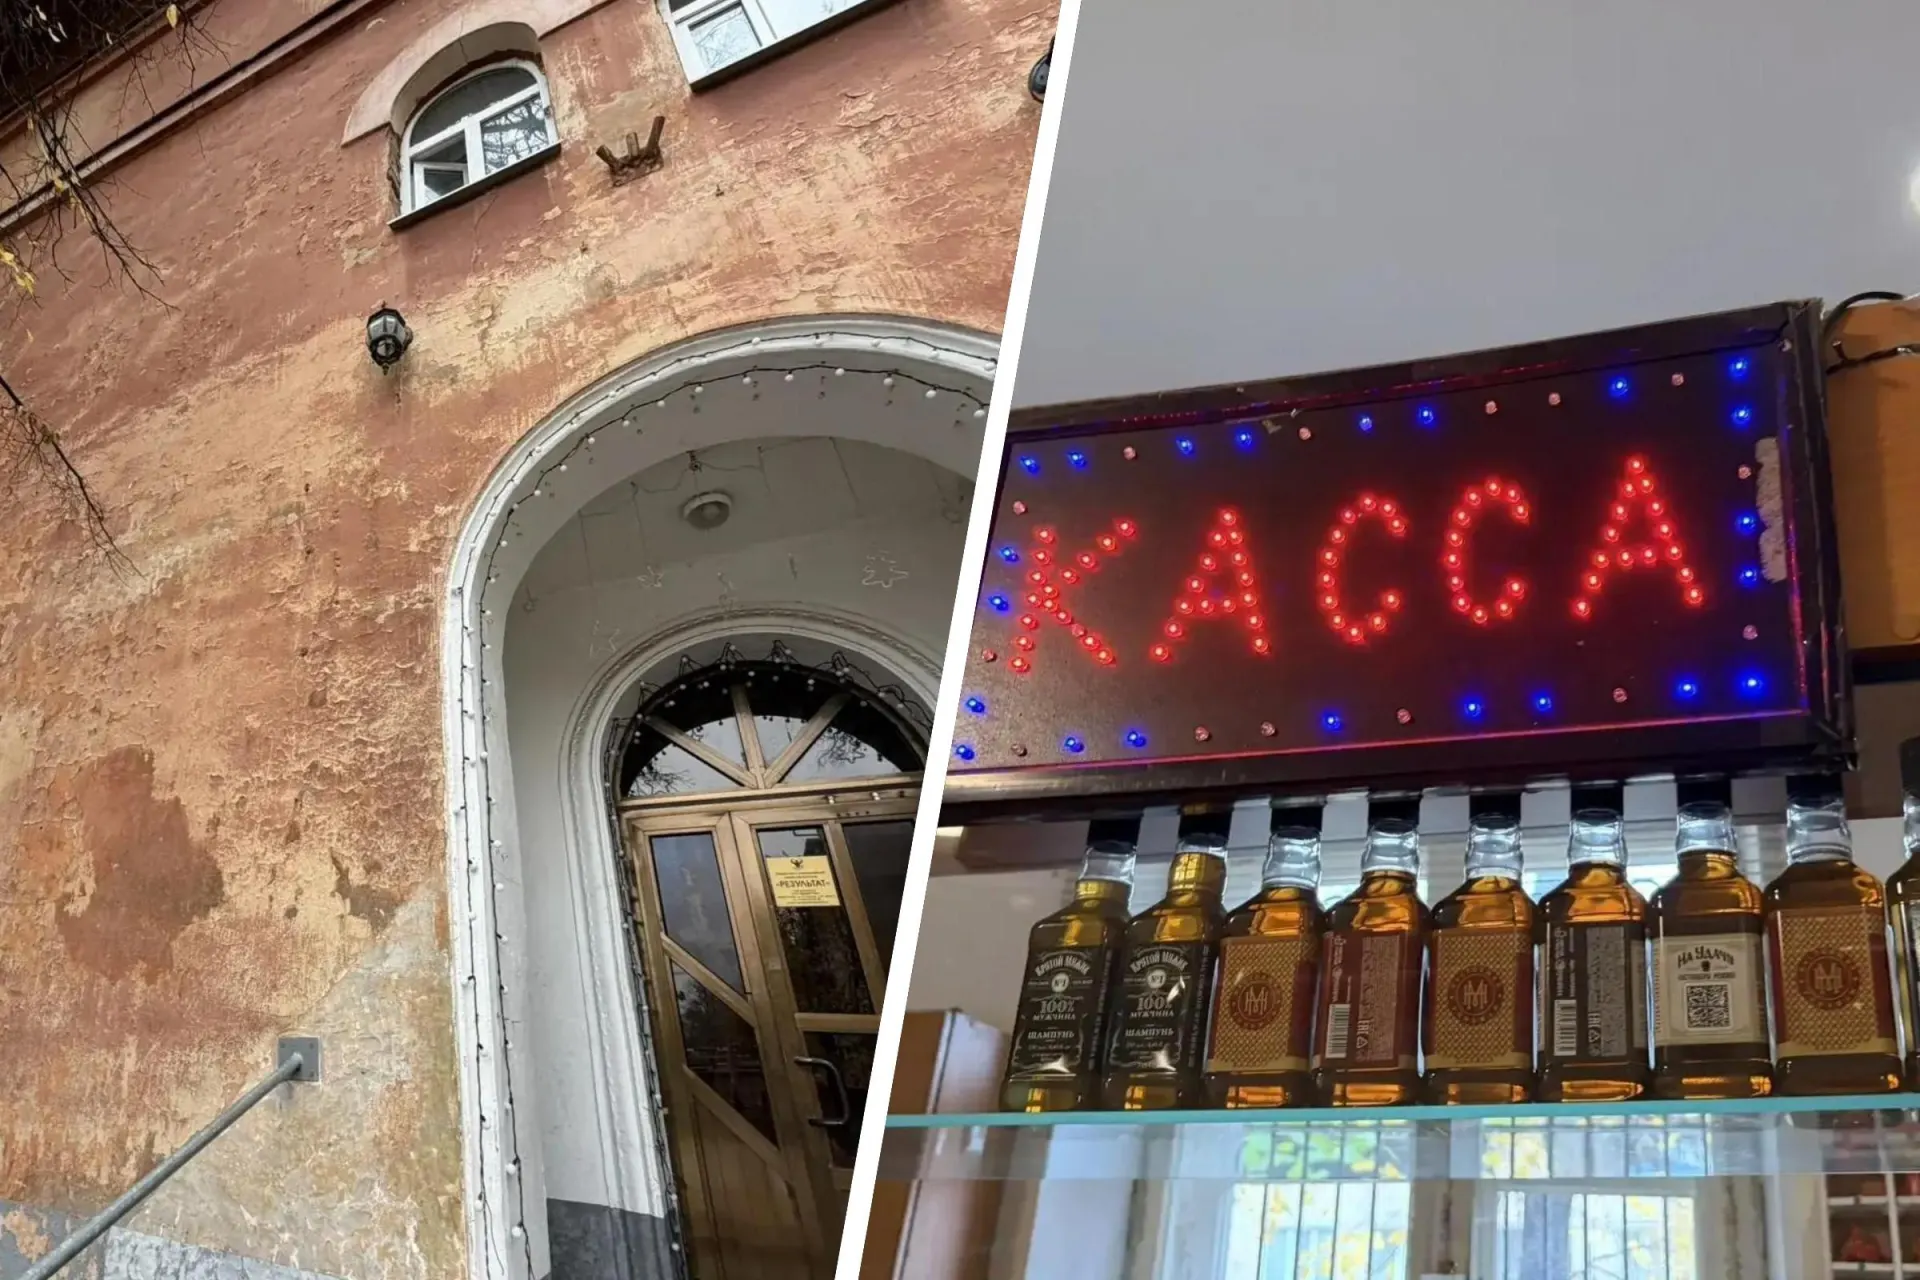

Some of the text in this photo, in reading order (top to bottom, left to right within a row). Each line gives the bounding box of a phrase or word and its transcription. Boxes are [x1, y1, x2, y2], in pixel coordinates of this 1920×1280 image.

[1010, 453, 1704, 674] КАССА
[1040, 999, 1075, 1014] 100%
[1032, 1012, 1076, 1021] МУЖЧИНА
[1129, 1009, 1175, 1019] МУЖЧИНА
[1027, 1030, 1075, 1040] ШАМПУНЬ
[1124, 1027, 1175, 1037] ШАМПУНЬ
